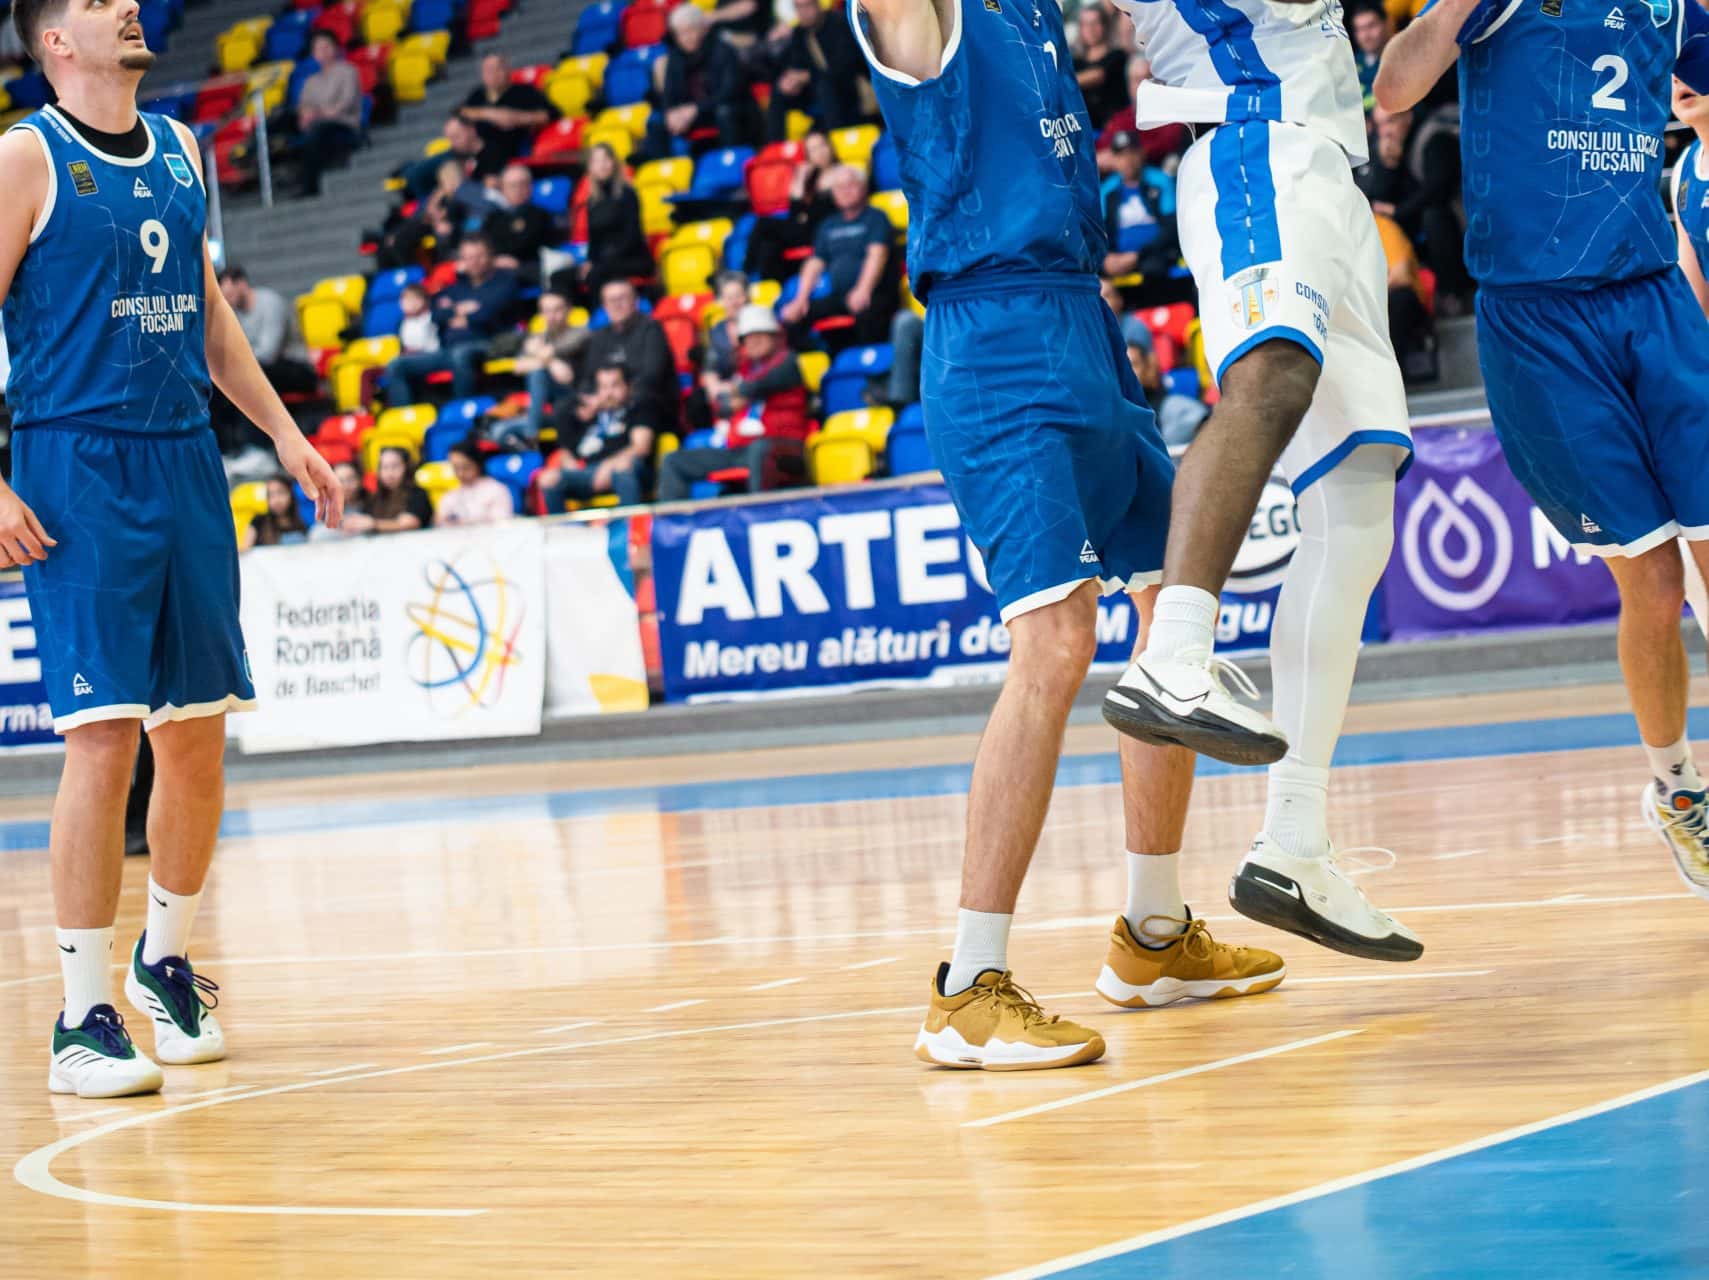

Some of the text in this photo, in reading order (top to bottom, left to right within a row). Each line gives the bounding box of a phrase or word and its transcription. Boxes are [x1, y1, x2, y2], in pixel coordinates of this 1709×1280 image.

[1603, 18, 1626, 31] PEAK
[1591, 54, 1630, 112] 2
[1547, 129, 1660, 158] CONSILIUL LOCAL
[140, 219, 169, 274] 9
[111, 294, 198, 318] CONSILIUL LOCAL
[676, 503, 996, 626] ARTE
[684, 640, 807, 678] Mereu
[818, 620, 950, 668] alături
[960, 616, 1011, 656] de
